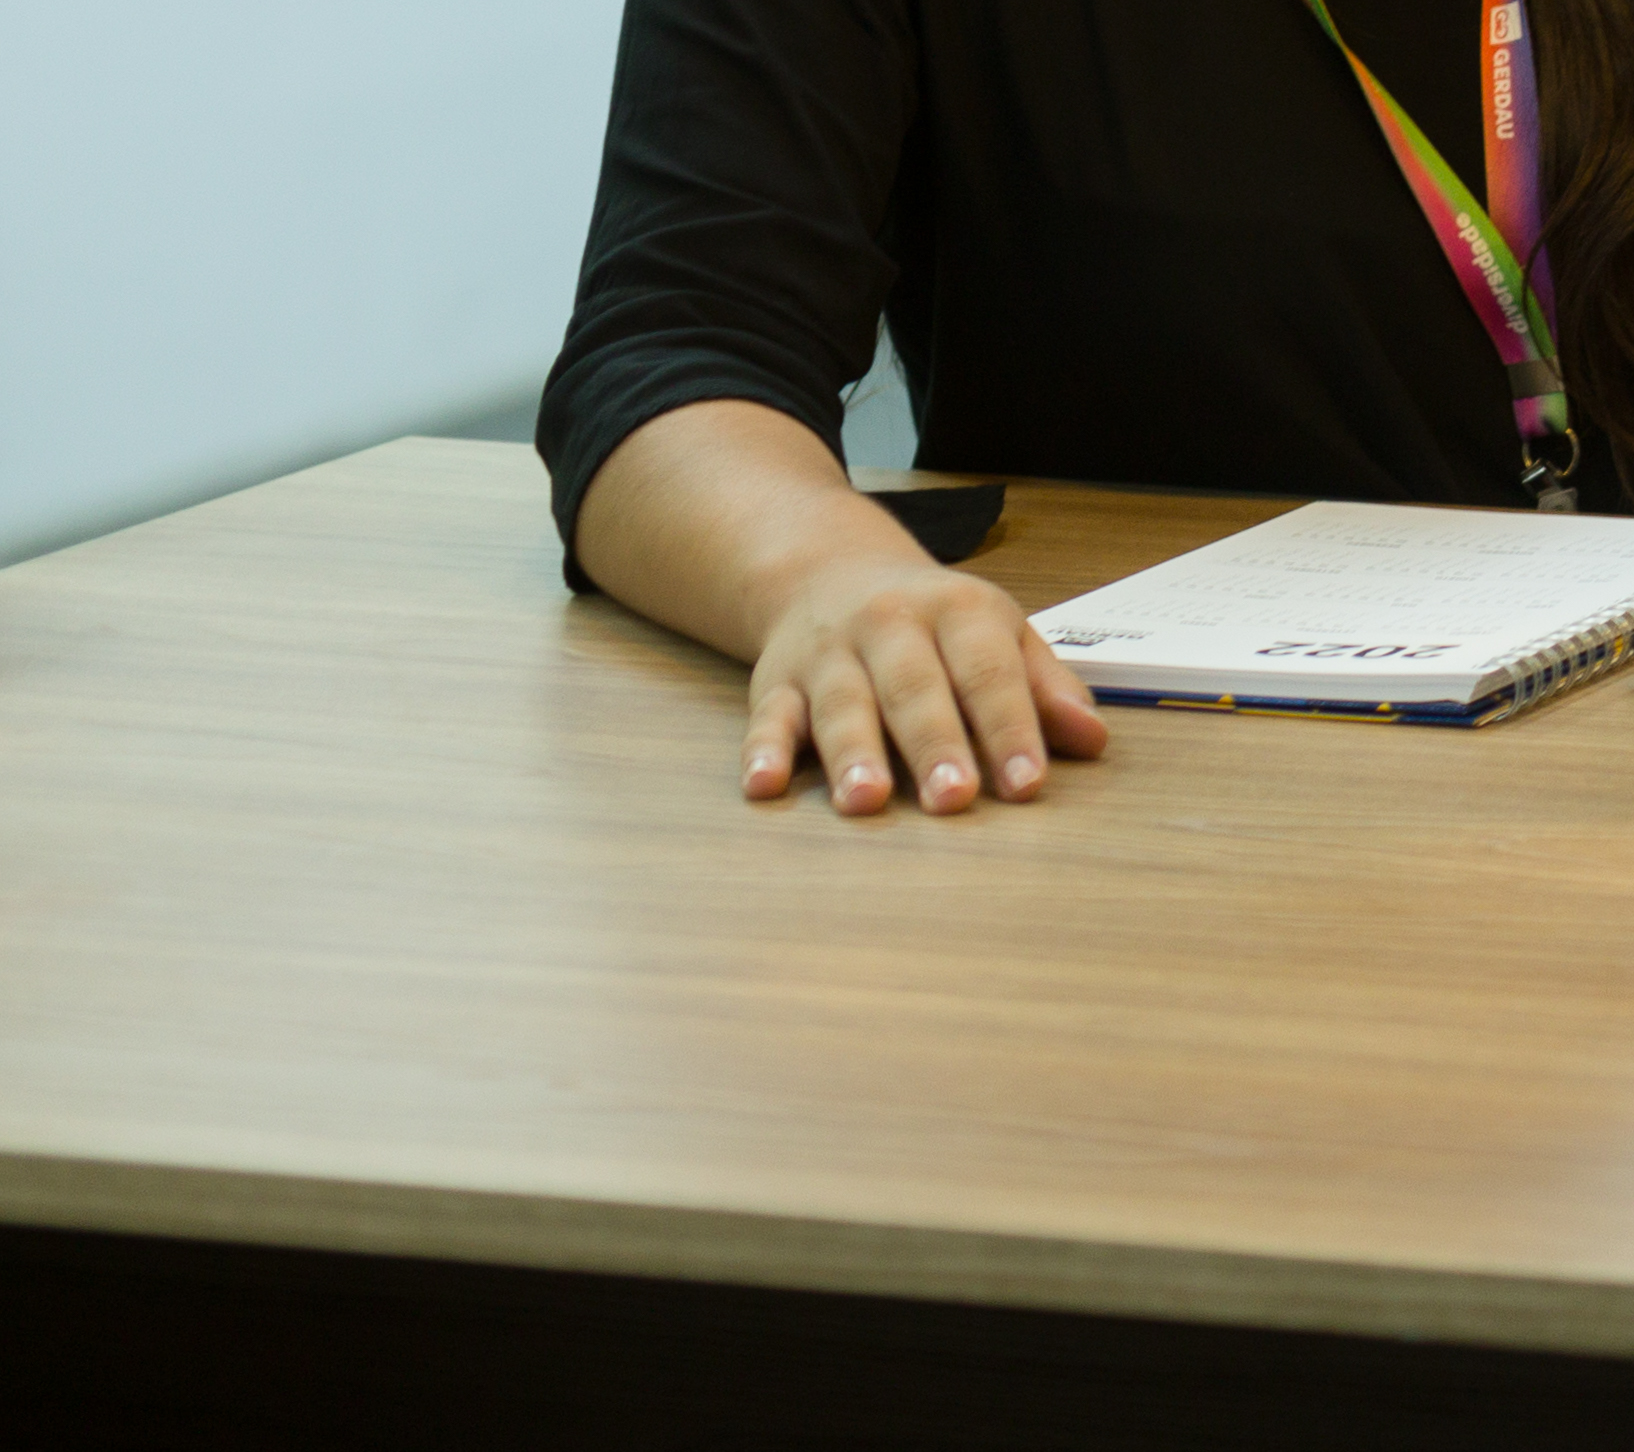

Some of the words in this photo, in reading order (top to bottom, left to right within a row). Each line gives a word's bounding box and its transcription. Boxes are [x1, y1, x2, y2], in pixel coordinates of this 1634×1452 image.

[1492, 47, 1515, 141] GERDAU
[1455, 210, 1529, 336] diversidade
[1253, 640, 1463, 658] 2022
